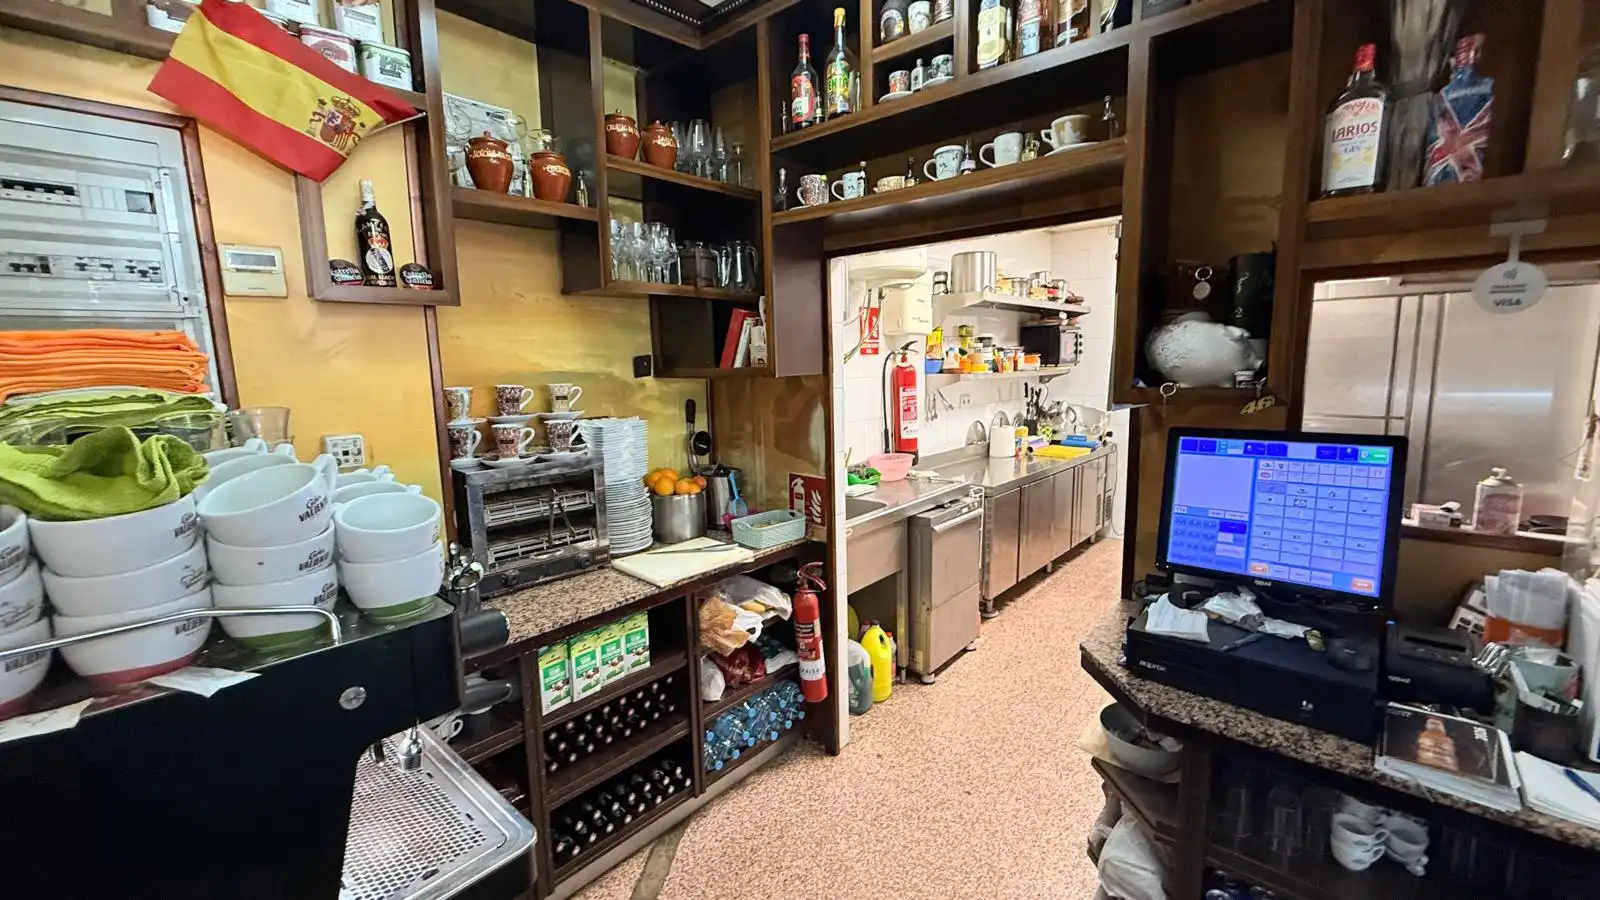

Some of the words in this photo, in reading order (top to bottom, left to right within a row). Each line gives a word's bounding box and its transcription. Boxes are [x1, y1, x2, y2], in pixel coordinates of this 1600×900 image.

[1332, 122, 1378, 143] LARIOS
[403, 270, 432, 279] Estrella
[1240, 395, 1276, 415] 46
[299, 496, 328, 522] VALIENT
[1139, 660, 1167, 672] approx
